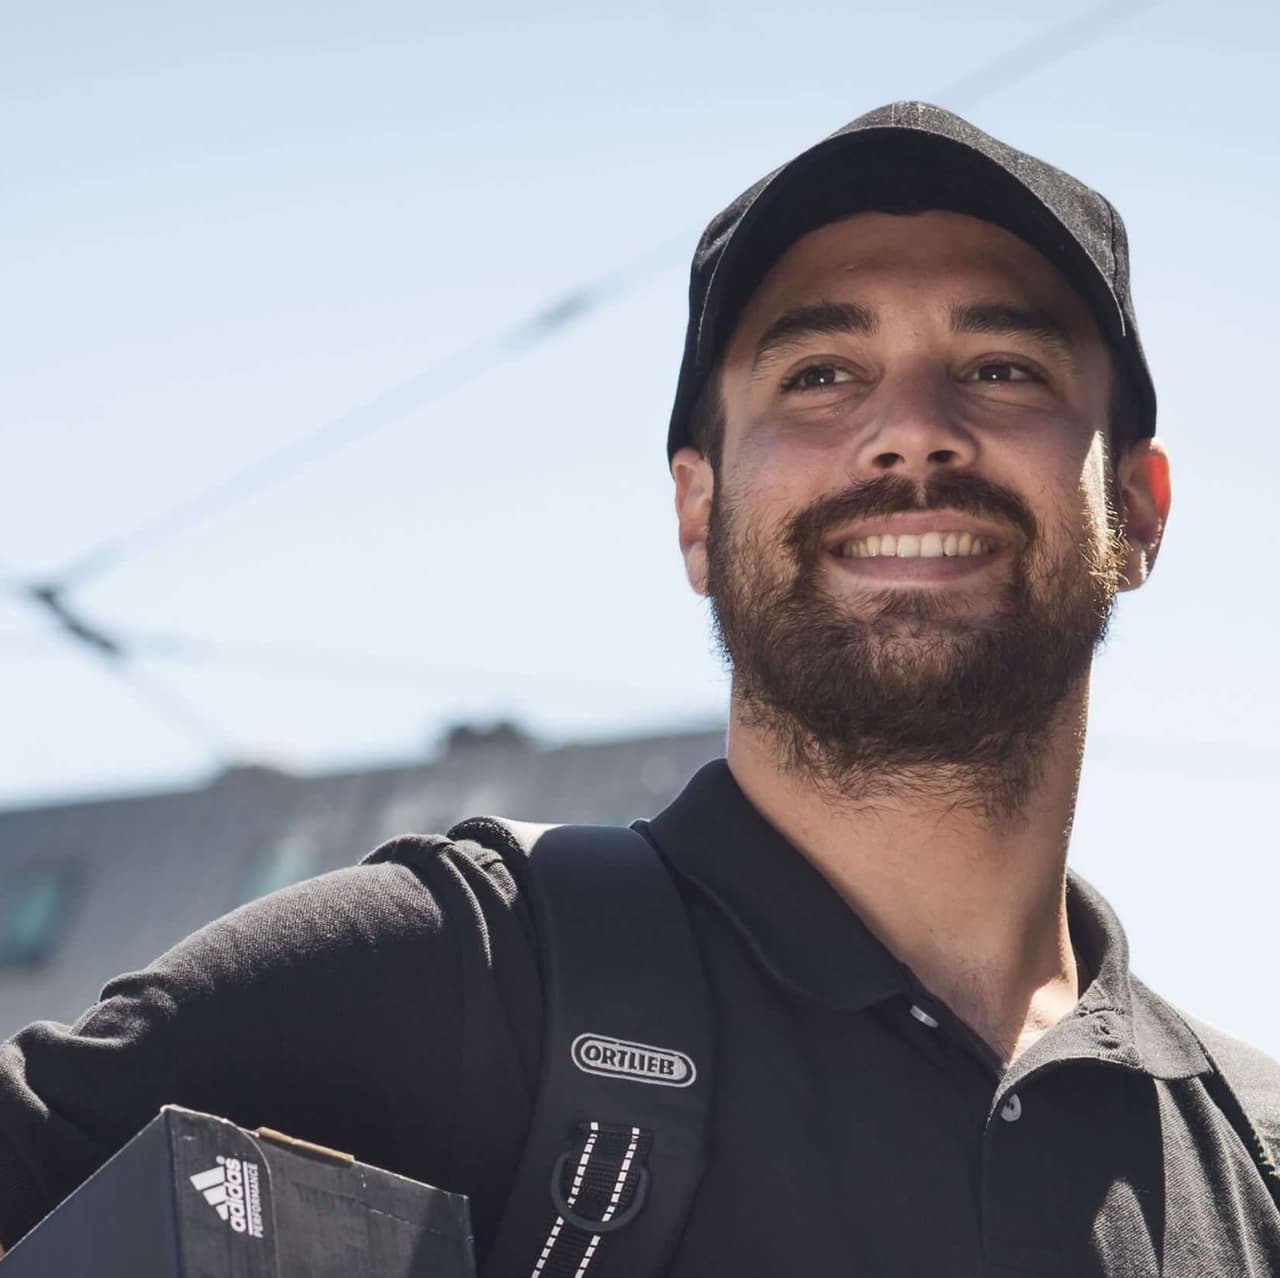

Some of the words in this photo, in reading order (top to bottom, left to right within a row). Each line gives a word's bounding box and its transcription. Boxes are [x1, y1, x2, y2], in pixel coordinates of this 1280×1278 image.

[584, 1043, 676, 1076] ORTLIEB
[224, 1157, 247, 1233] adidas
[247, 1162, 264, 1239] PERFORMANCE
